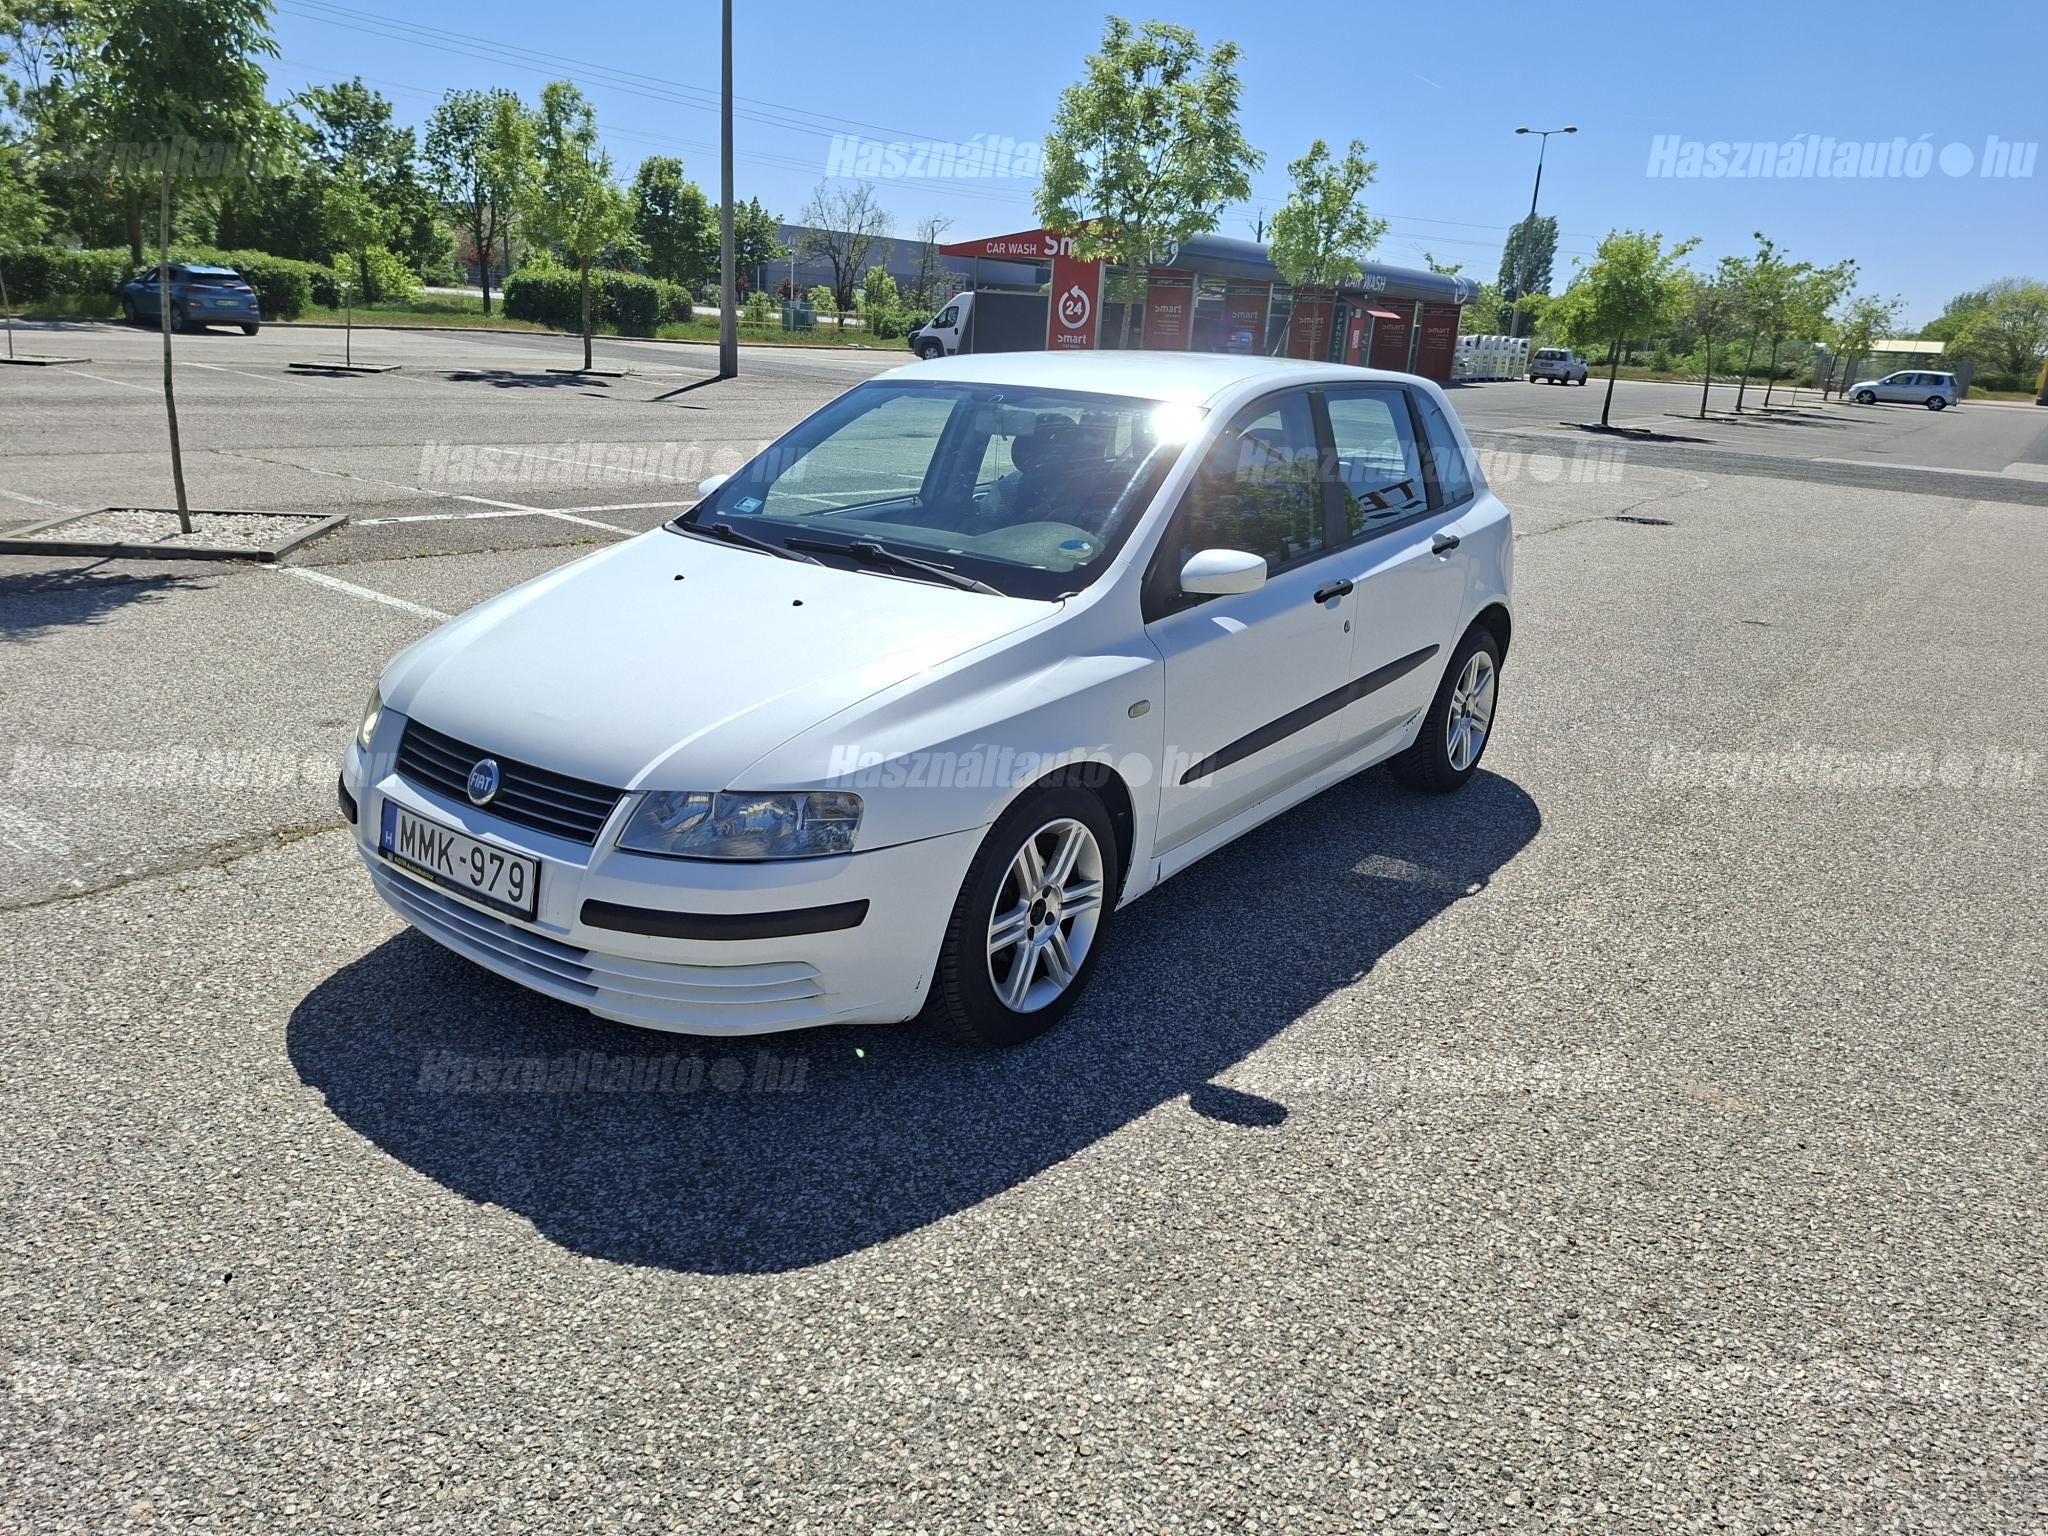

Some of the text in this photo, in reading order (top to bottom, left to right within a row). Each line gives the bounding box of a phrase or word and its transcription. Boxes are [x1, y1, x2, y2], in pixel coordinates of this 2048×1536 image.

[986, 243, 1037, 255] CAR WASH
[1363, 273, 1386, 291] WASH
[1065, 301, 1082, 315] 24
[470, 774, 492, 791] FIAT
[385, 832, 392, 845] H
[400, 815, 524, 902] MMK-979
